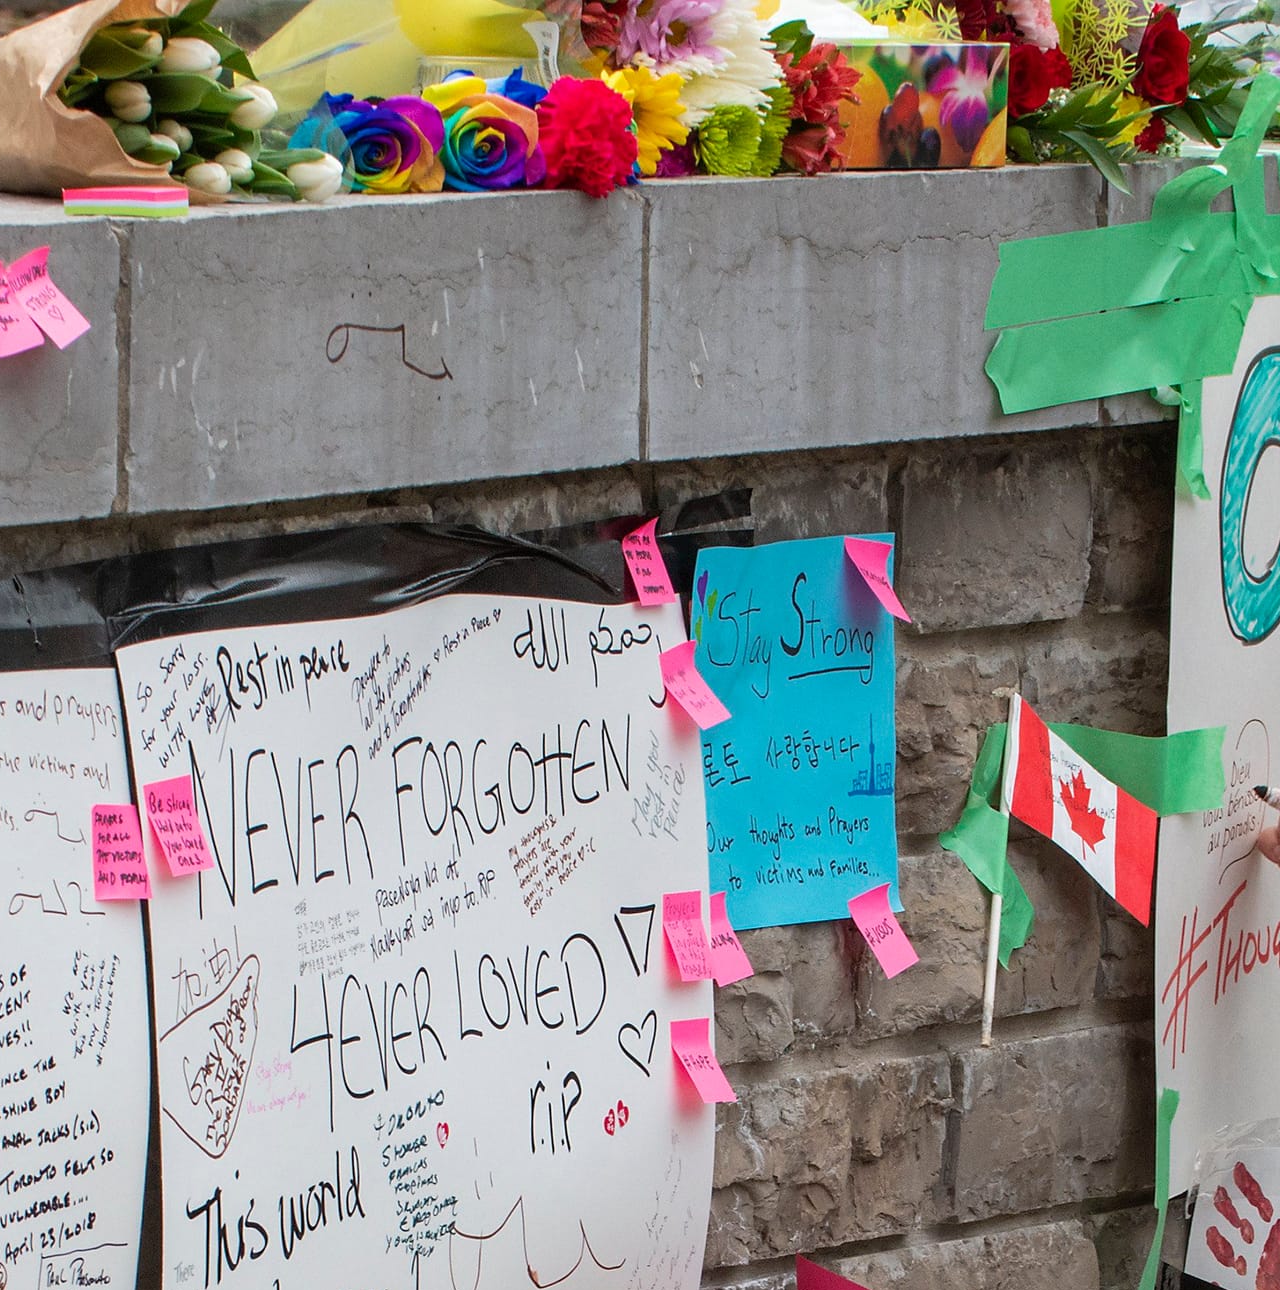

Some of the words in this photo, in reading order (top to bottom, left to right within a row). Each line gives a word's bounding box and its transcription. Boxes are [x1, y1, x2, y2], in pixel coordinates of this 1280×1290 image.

[708, 591, 772, 699] Stay
[780, 572, 875, 686] Strong
[216, 641, 269, 722] Rest
[274, 645, 294, 694] in
[16, 689, 46, 722] and
[141, 727, 156, 751] for
[29, 752, 76, 779] victims
[83, 762, 110, 792] and
[703, 742, 752, 788] 론토
[189, 738, 374, 920] NEVER
[749, 812, 796, 861] thoughts
[729, 864, 743, 892] to
[10, 963, 27, 985] OF
[291, 966, 447, 1132] 4EVER
[454, 932, 608, 1041] LOVED
[33, 1055, 57, 1073] THE
[45, 1080, 67, 1104] BOY
[0, 1166, 57, 1197] TORONTO
[100, 1148, 114, 1167] SO
[187, 1170, 269, 1290] This
[279, 1146, 366, 1261] world
[4, 1231, 34, 1265] April
